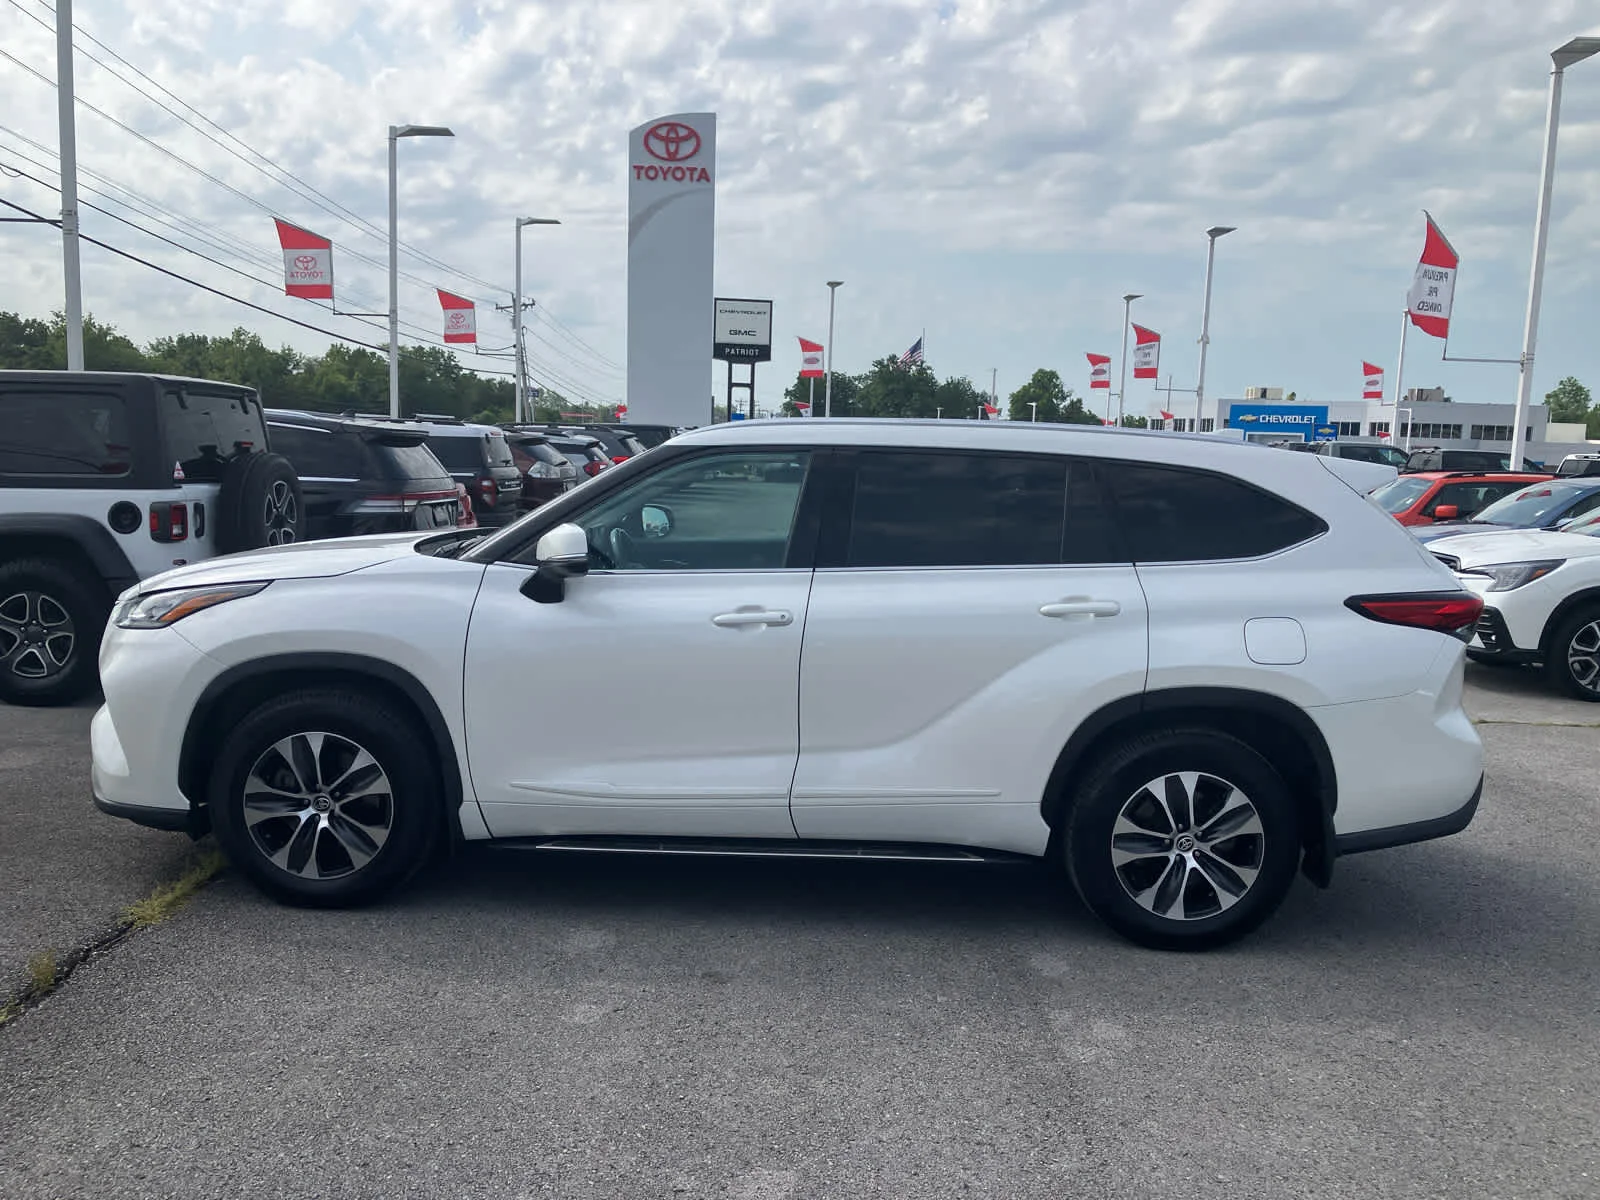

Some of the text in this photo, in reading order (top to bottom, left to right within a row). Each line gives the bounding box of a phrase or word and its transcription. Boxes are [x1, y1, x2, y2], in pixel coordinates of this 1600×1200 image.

[632, 165, 711, 183] TOYOTA
[728, 328, 757, 337] GMC
[725, 347, 759, 357] PATRIOT
[1259, 414, 1316, 424] CHEVROLET
